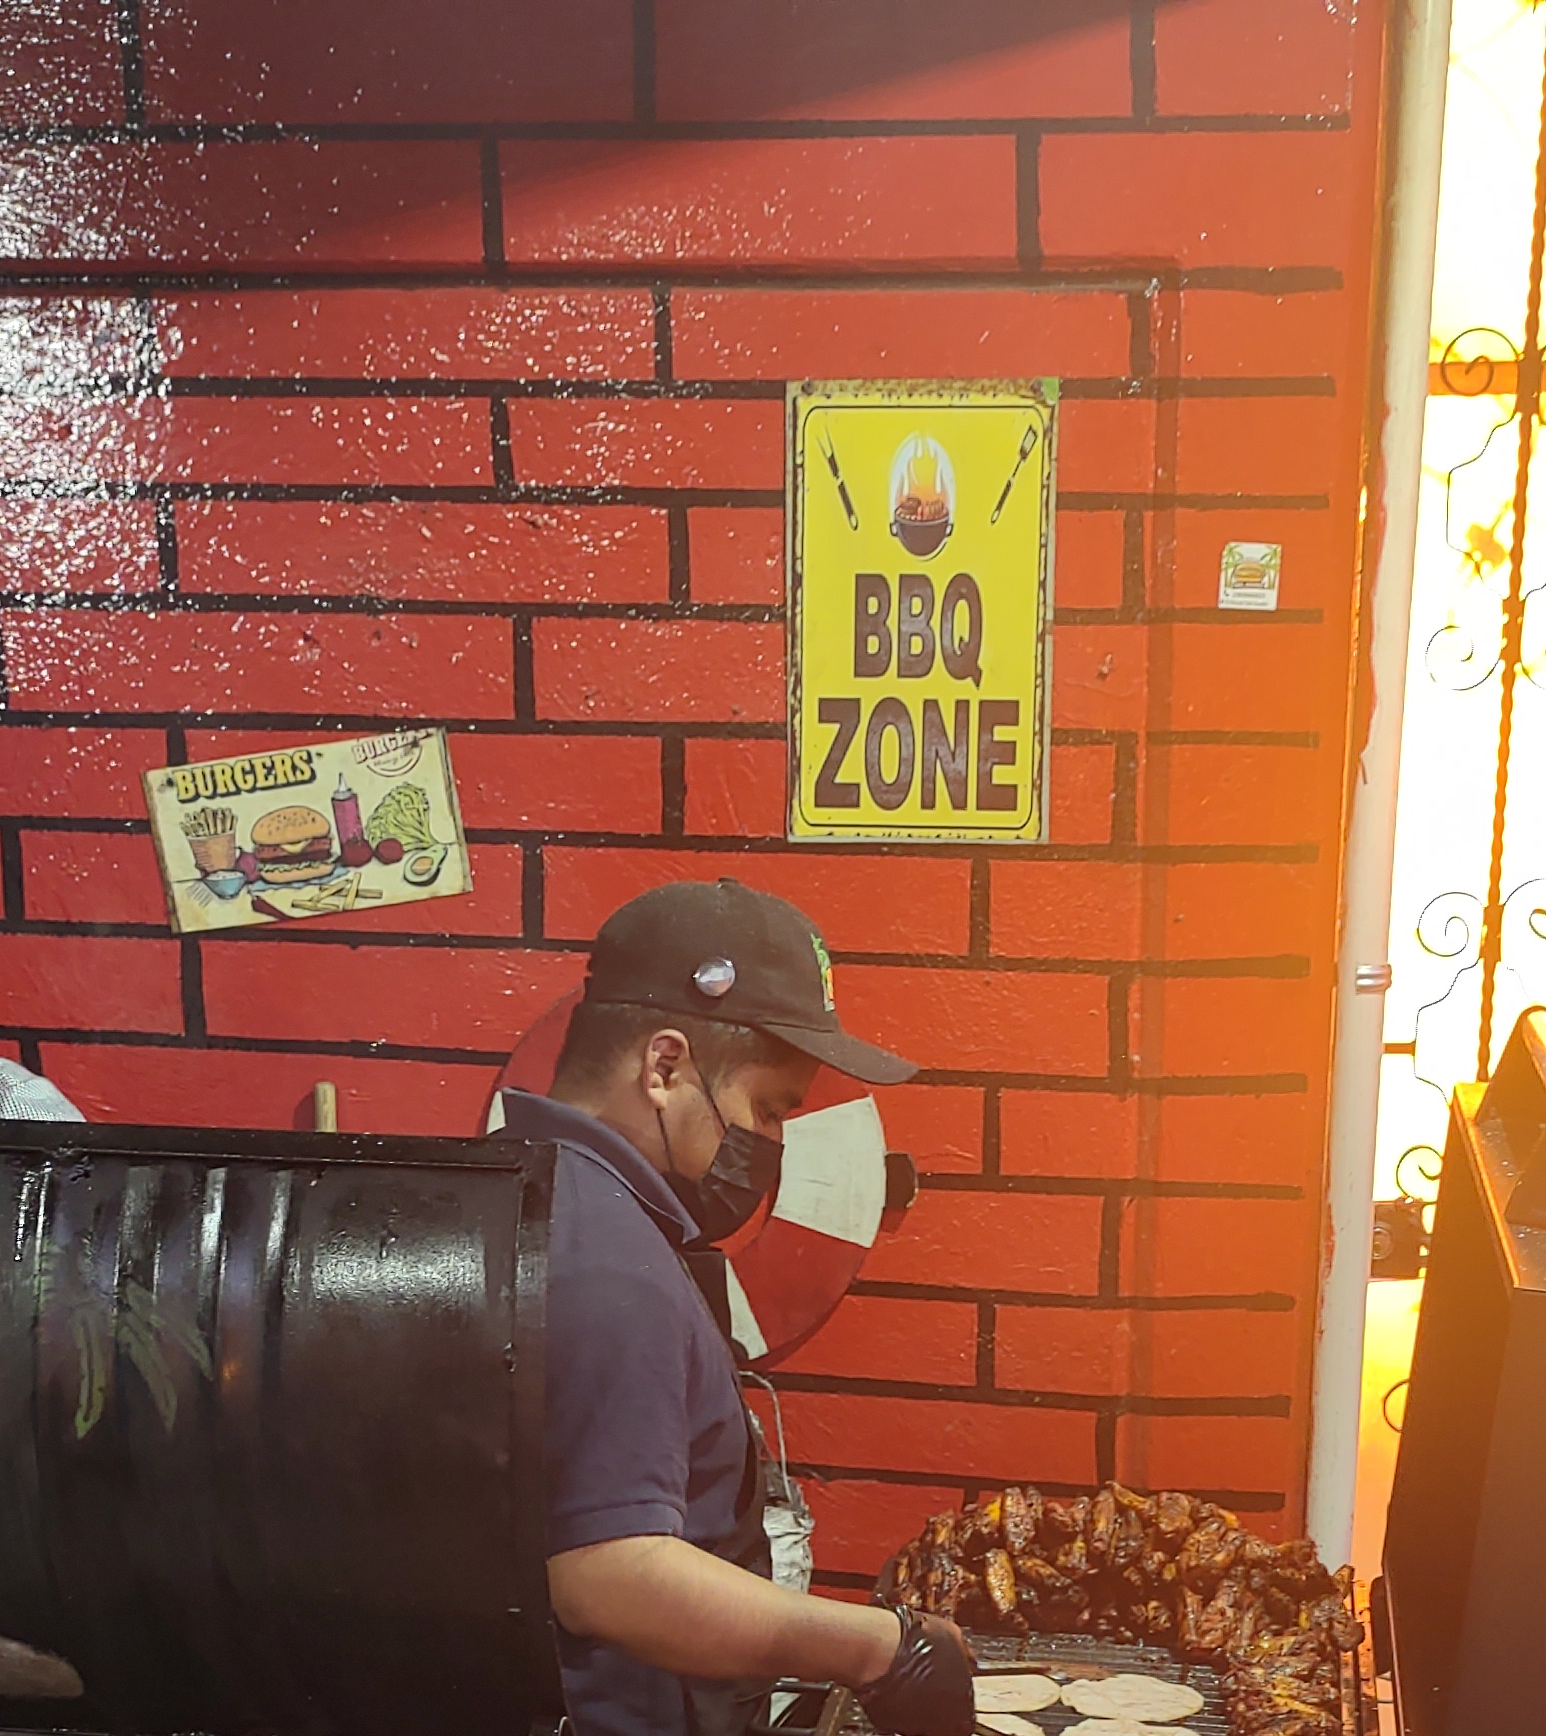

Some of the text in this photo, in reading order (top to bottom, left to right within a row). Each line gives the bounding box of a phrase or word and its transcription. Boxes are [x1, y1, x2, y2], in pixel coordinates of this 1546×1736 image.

[853, 573, 983, 690] BBQ
[174, 750, 316, 803] BURGERS
[814, 697, 1020, 811] ZONE
